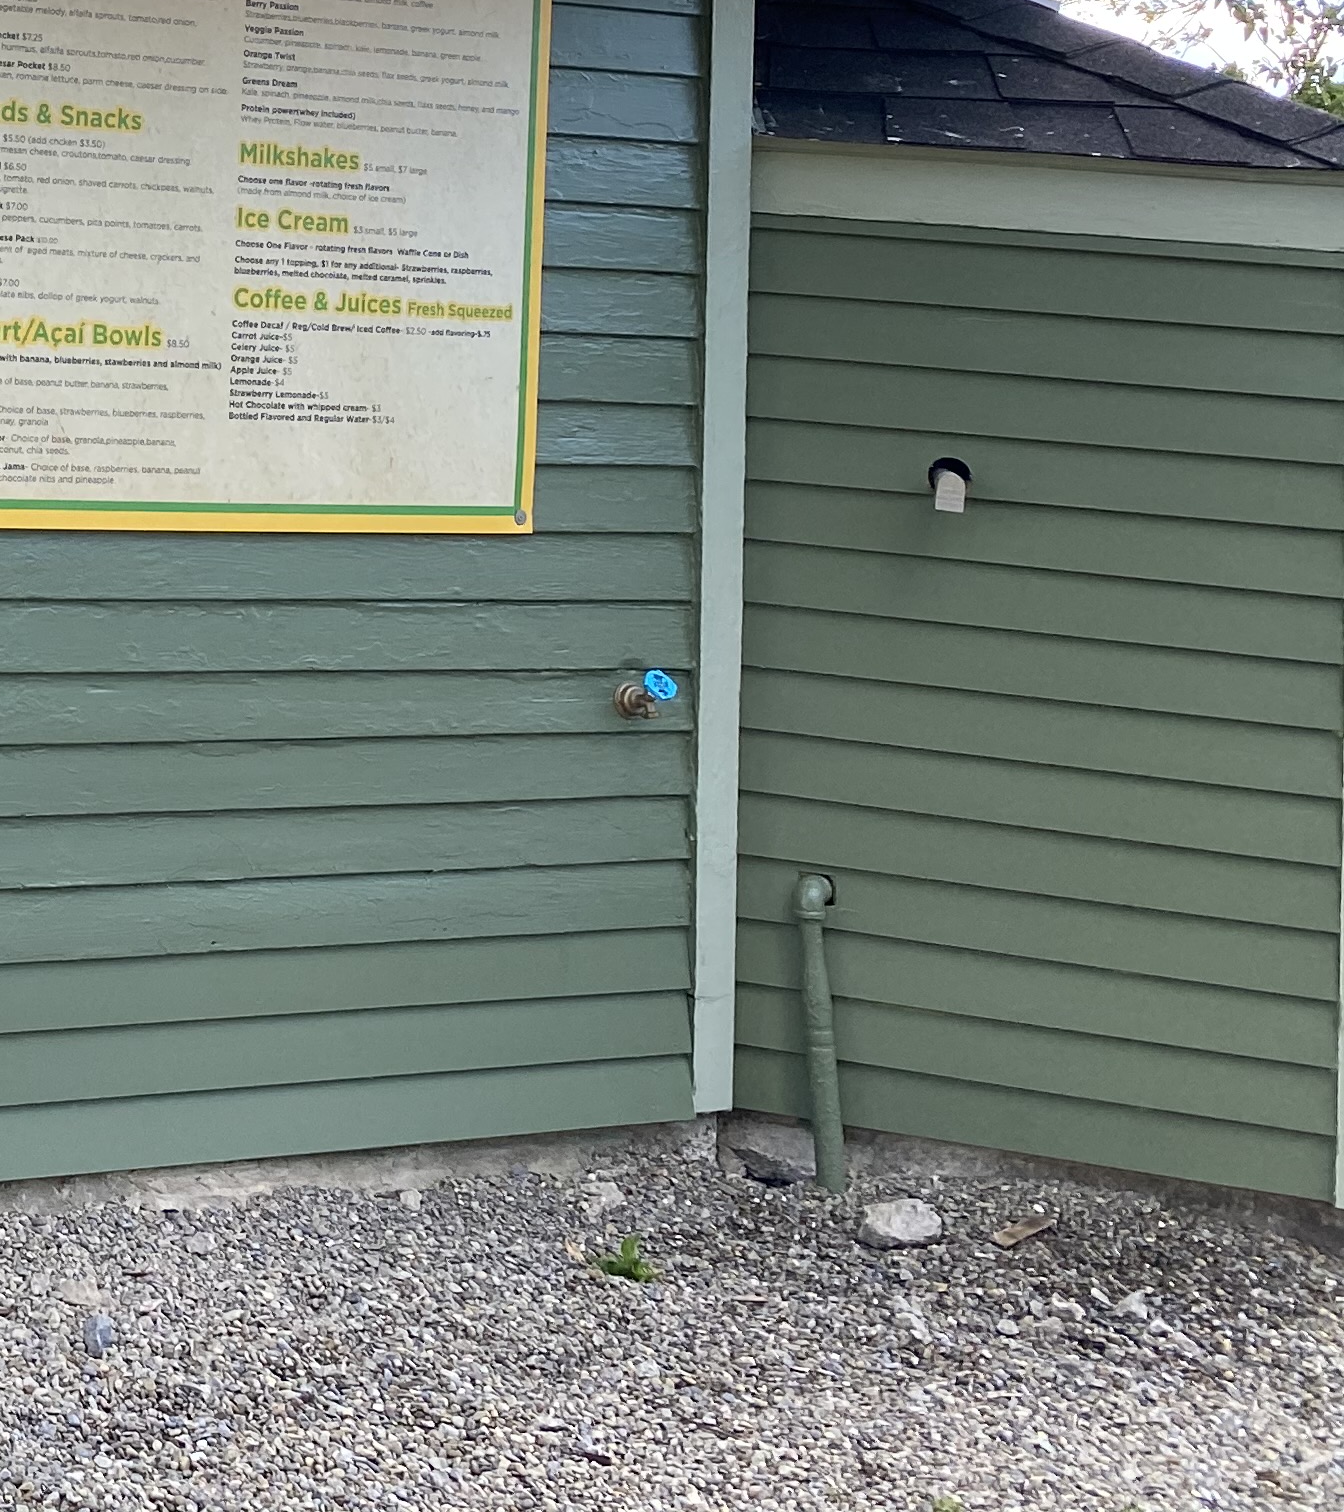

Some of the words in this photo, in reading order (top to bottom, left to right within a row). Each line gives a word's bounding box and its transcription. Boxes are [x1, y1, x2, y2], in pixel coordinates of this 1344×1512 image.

[36, 103, 52, 125] &
[60, 104, 142, 131] Snacks
[239, 142, 360, 171] Milkshakes
[237, 206, 270, 230] Ice
[277, 209, 349, 234] Cream
[233, 287, 307, 311] Coffee
[313, 291, 329, 312] &
[334, 292, 402, 315] Juices
[92, 323, 162, 347] Bowls
